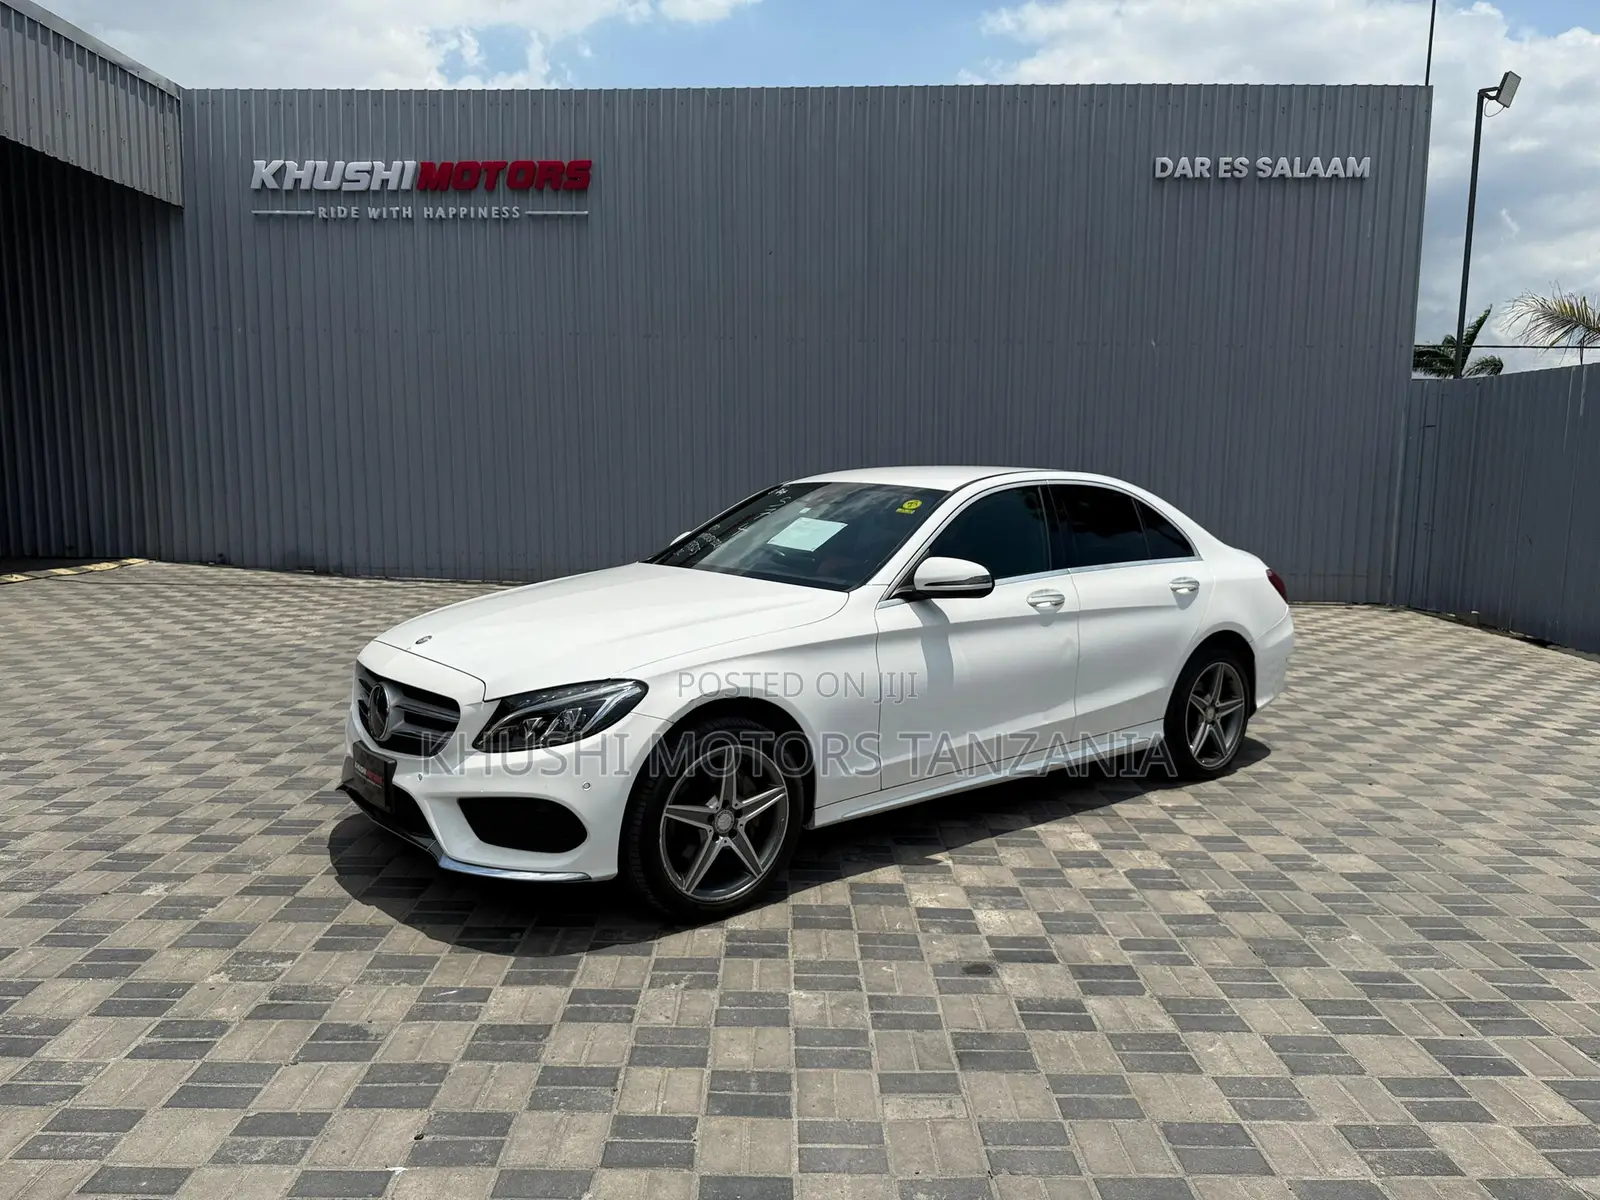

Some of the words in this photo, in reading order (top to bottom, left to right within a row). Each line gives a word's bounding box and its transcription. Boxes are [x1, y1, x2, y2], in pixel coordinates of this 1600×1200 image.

[1154, 157, 1211, 179] DAR
[1218, 157, 1250, 179] ES
[1255, 157, 1371, 179] SALAAM
[319, 206, 360, 219] RIDE
[368, 206, 412, 219] WITH
[423, 206, 521, 219] HAPPINESS
